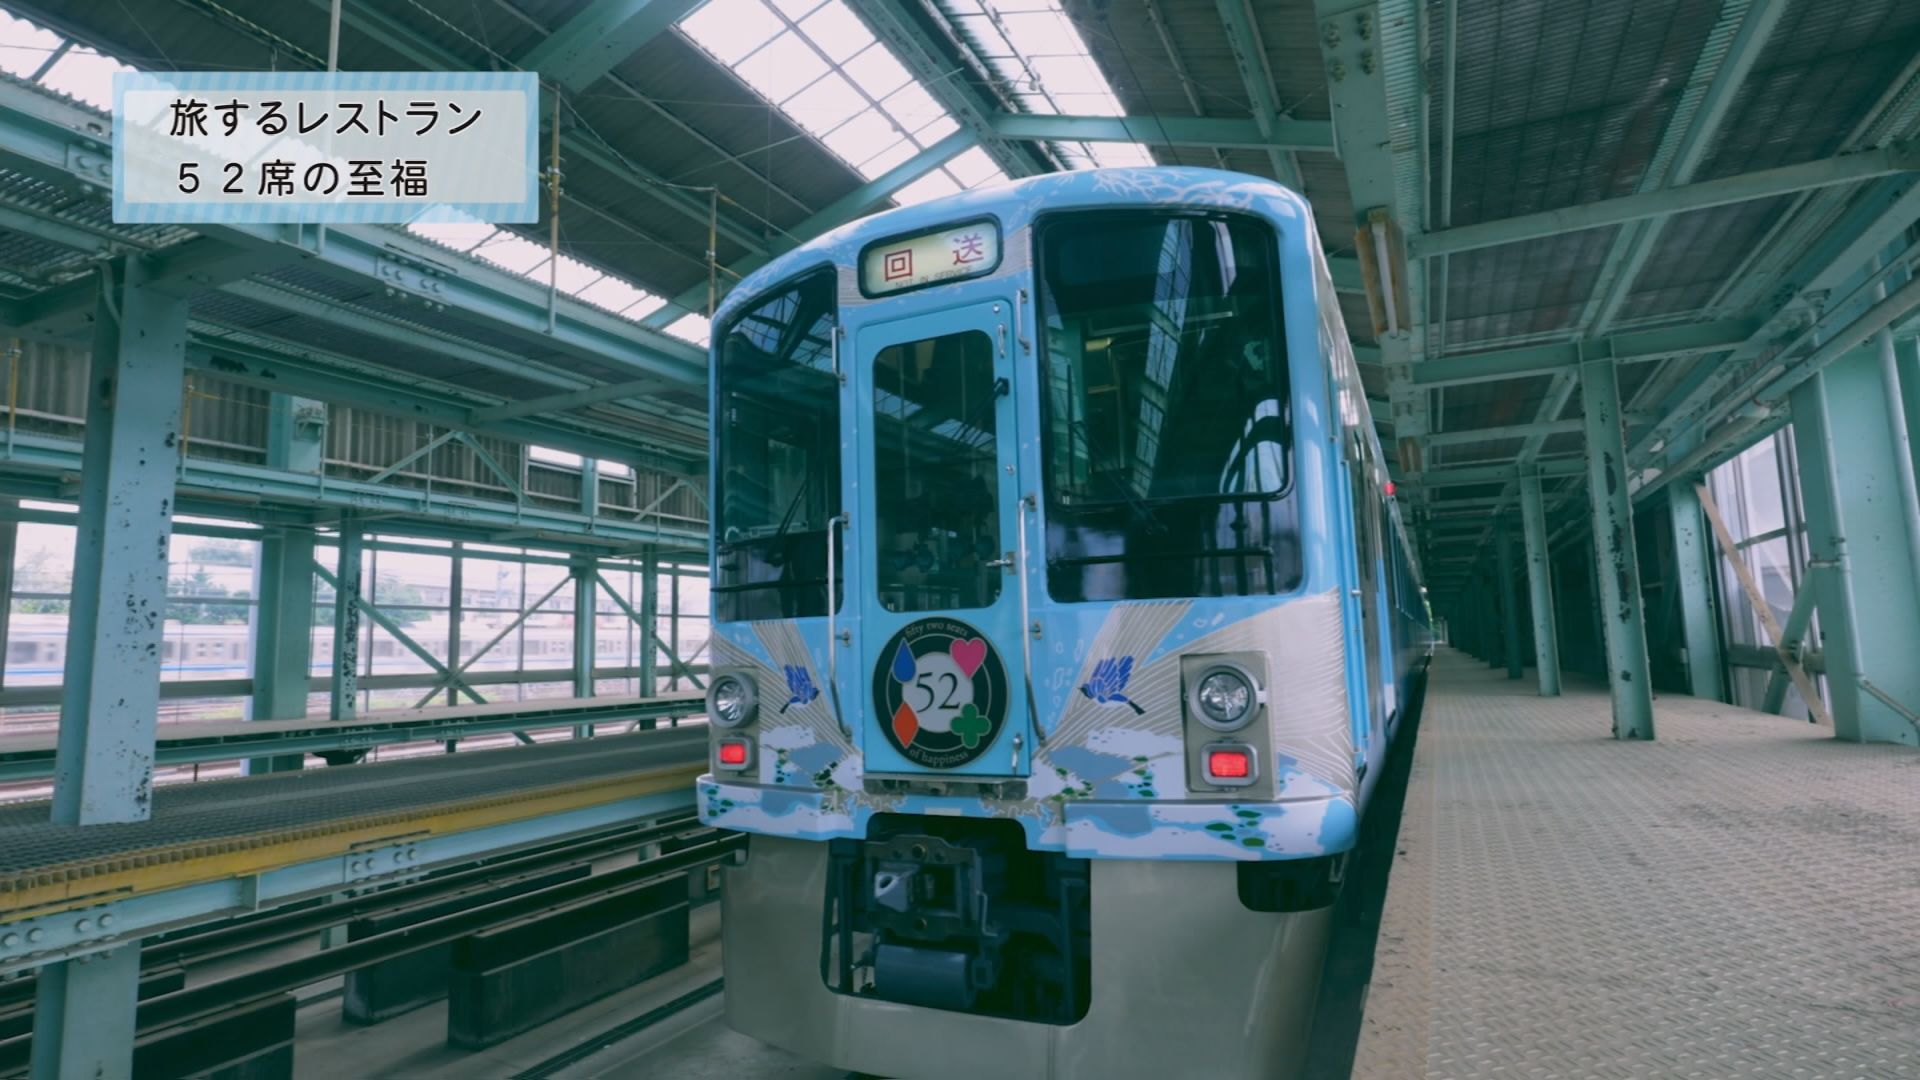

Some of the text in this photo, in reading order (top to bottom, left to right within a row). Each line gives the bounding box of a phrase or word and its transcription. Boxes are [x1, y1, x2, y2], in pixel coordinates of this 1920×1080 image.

[884, 232, 985, 281] 回送
[904, 621, 968, 638] fifty two seats
[916, 671, 961, 713] 52
[908, 749, 969, 767] of happiness
